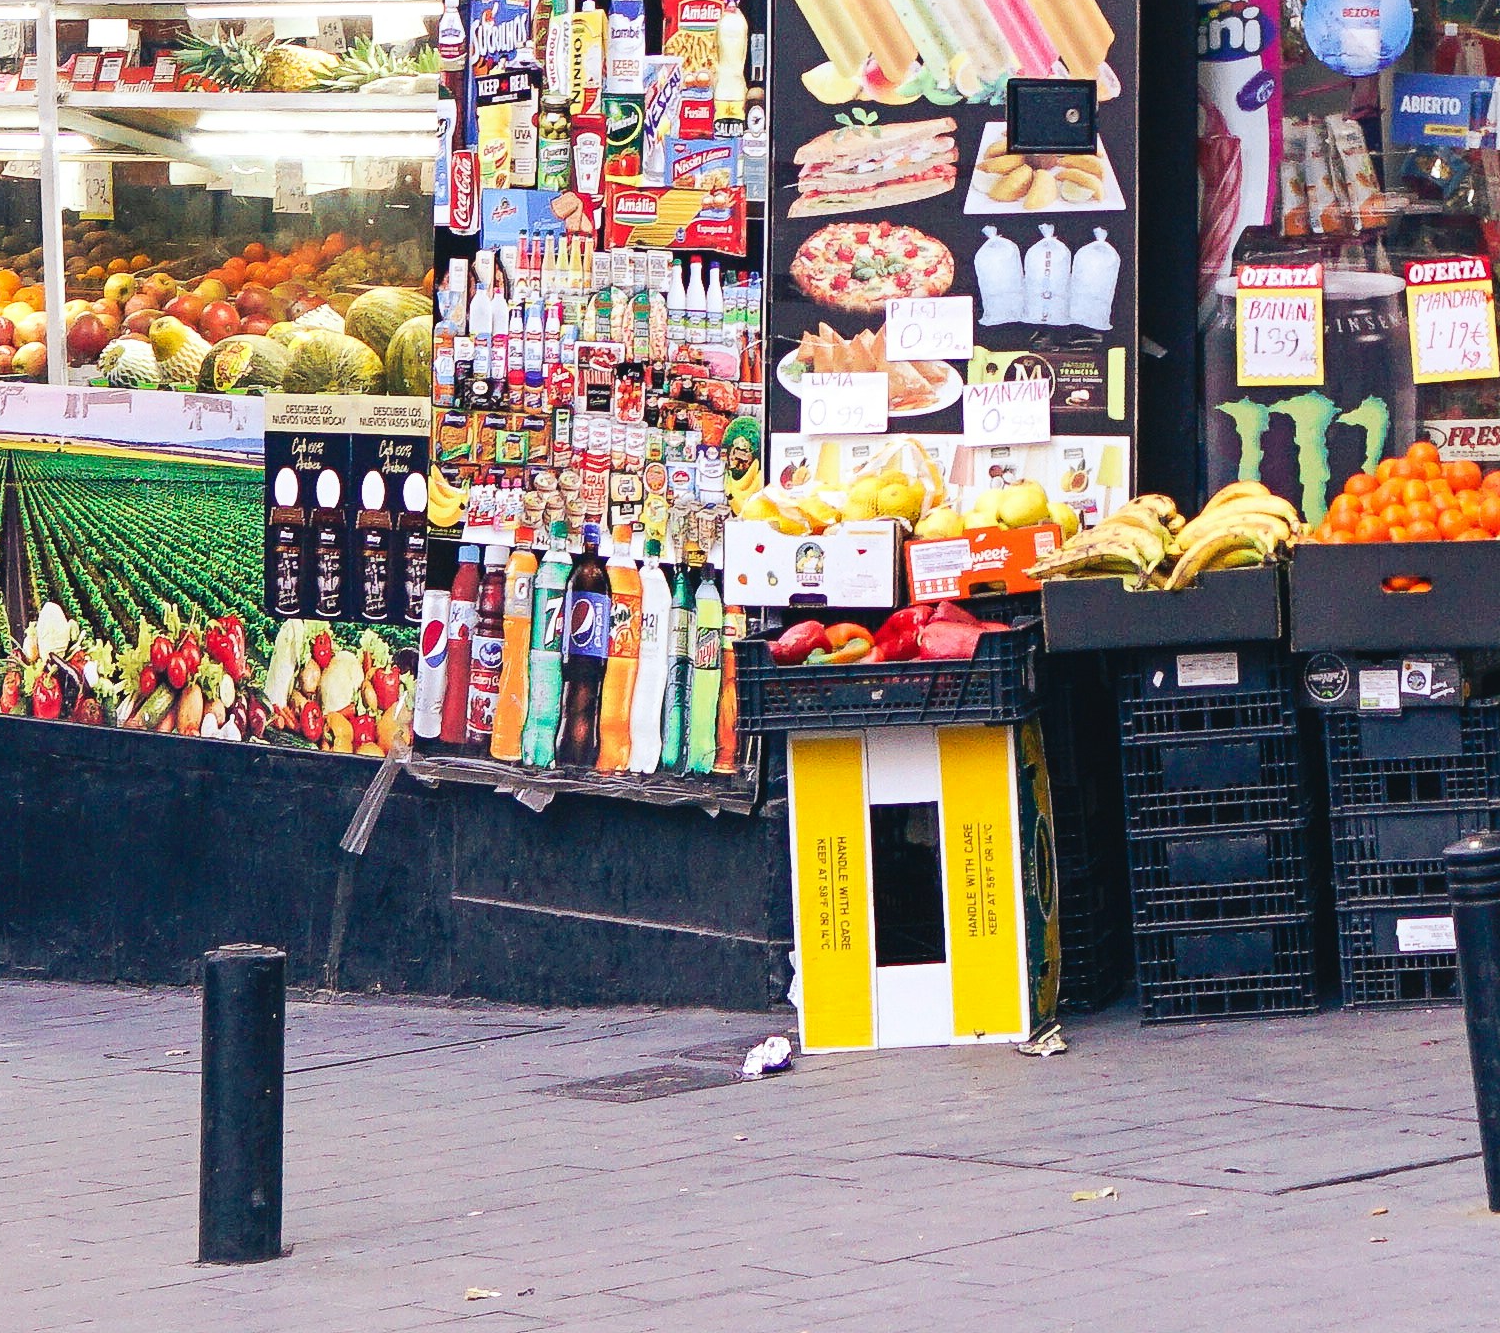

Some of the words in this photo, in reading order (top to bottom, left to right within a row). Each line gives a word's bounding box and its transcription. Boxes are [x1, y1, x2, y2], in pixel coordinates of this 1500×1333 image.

[681, 3, 722, 22] Amália
[477, 77, 500, 97] KEEP
[509, 73, 531, 93] REAL
[1400, 94, 1462, 116] ABIERTO
[513, 128, 532, 141] UVA
[616, 197, 656, 215] Amália
[1240, 266, 1318, 287] OFERTA
[1408, 259, 1487, 284] OFERTA
[963, 823, 974, 855] CARE
[816, 838, 827, 865] KEEP
[837, 836, 849, 883] HANDLE
[985, 848, 995, 864] OR
[818, 868, 828, 882] AT
[965, 859, 976, 890] WITH
[838, 886, 850, 916] WITH
[986, 893, 997, 908] AT
[820, 911, 829, 925] OR
[967, 892, 978, 938] HANDLE
[987, 909, 998, 936] KEEP
[840, 918, 852, 951] CARE
